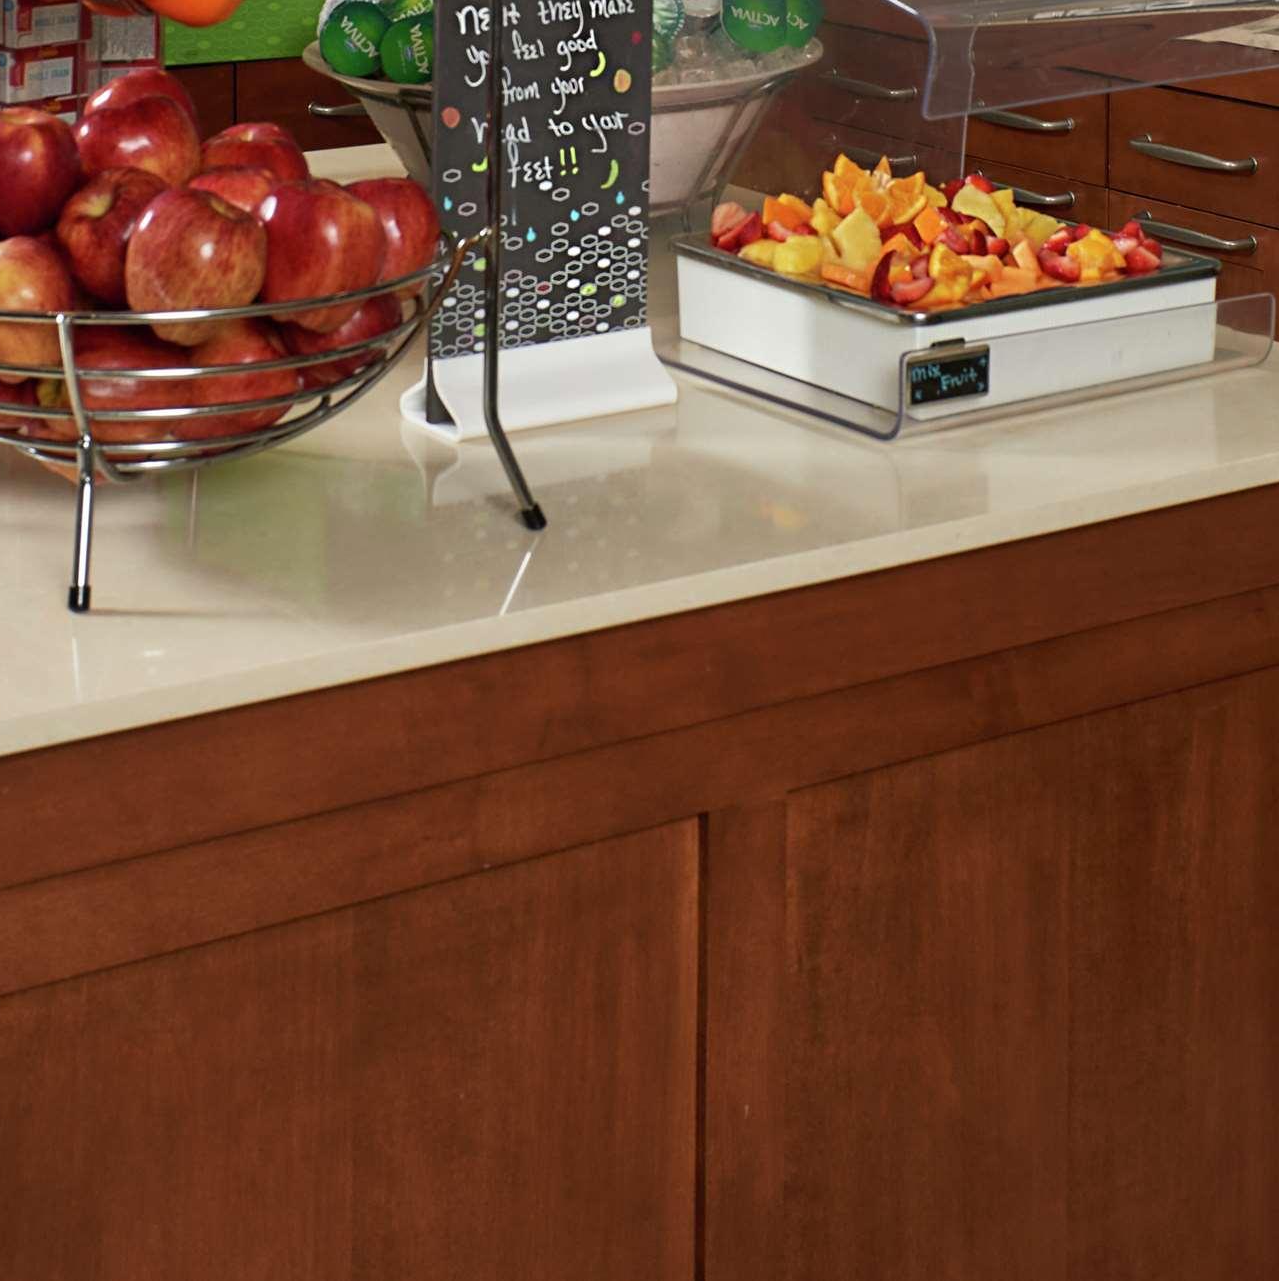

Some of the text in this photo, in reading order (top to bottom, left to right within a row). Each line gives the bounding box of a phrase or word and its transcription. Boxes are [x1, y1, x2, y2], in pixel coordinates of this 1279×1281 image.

[340, 14, 380, 58] ACTIVIA
[730, 5, 781, 27] ACTIVIA
[409, 22, 430, 75] ACTIVIA
[556, 27, 598, 72] good
[548, 118, 576, 138] to
